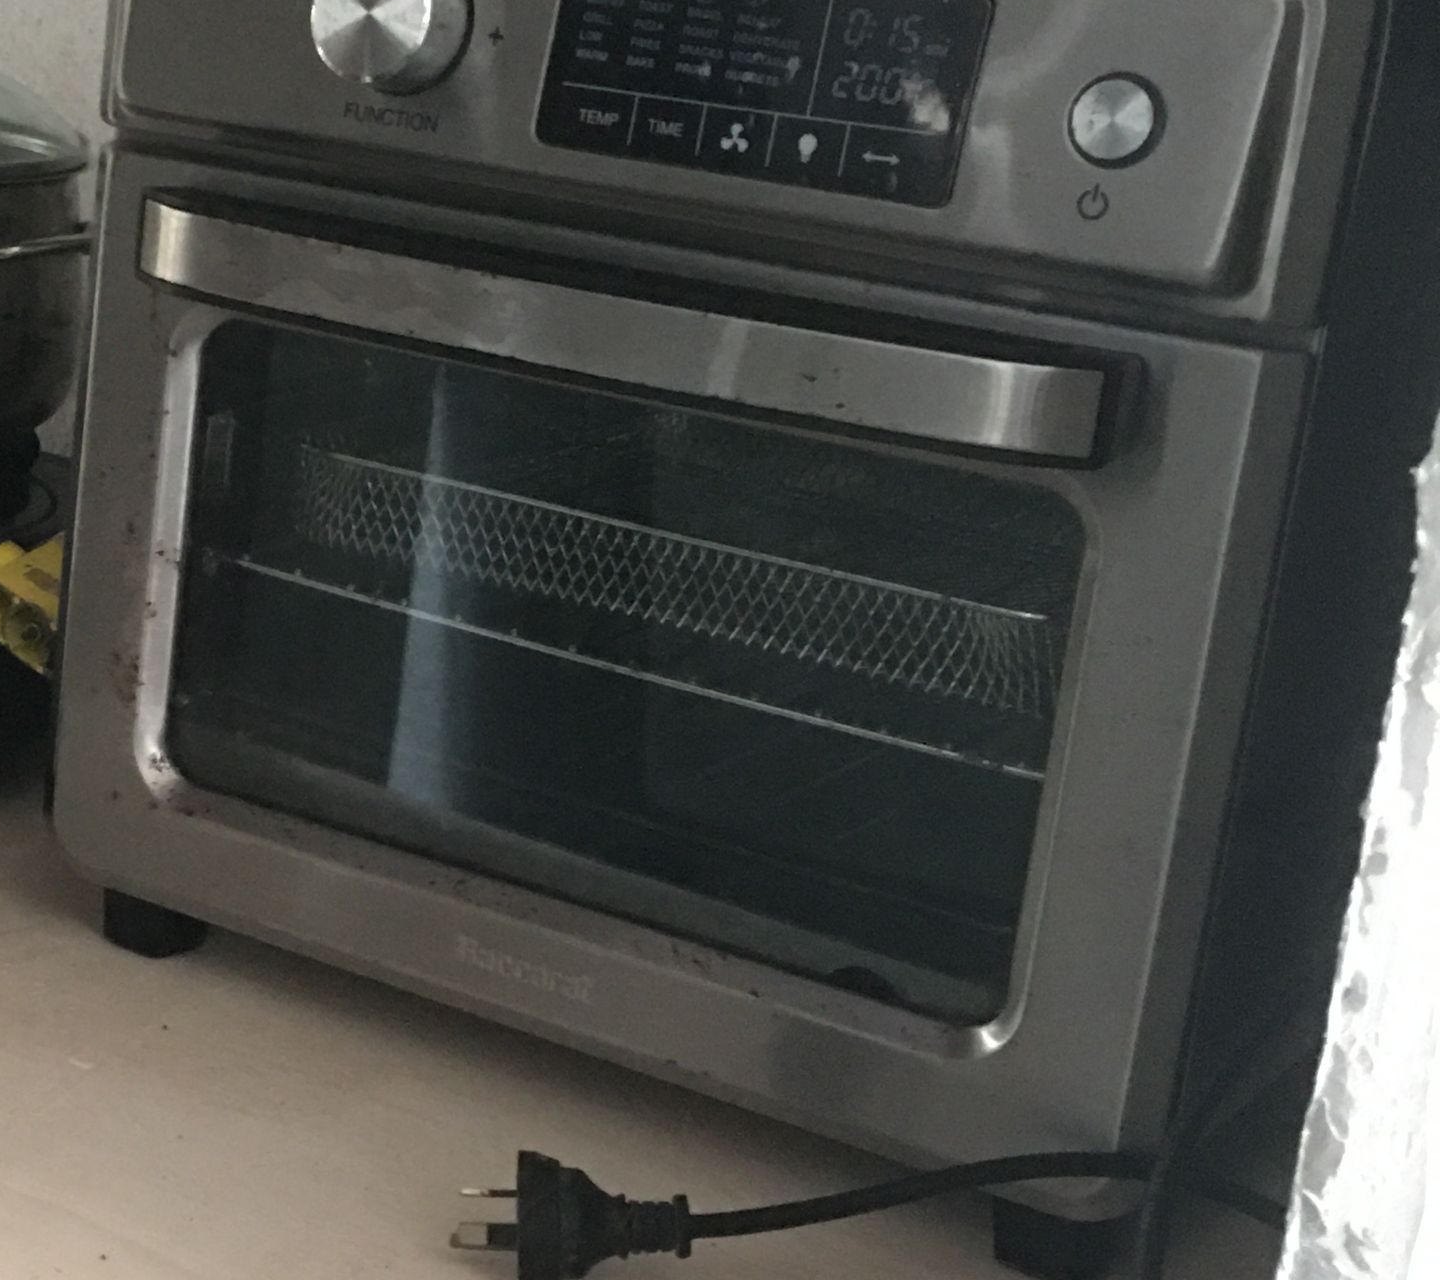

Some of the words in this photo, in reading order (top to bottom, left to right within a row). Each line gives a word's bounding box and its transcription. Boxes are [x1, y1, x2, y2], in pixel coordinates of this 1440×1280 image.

[343, 101, 441, 134] FUNCTION
[578, 108, 619, 127] TEMP
[647, 118, 684, 137] TIME
[455, 932, 594, 1004] Baccarat
